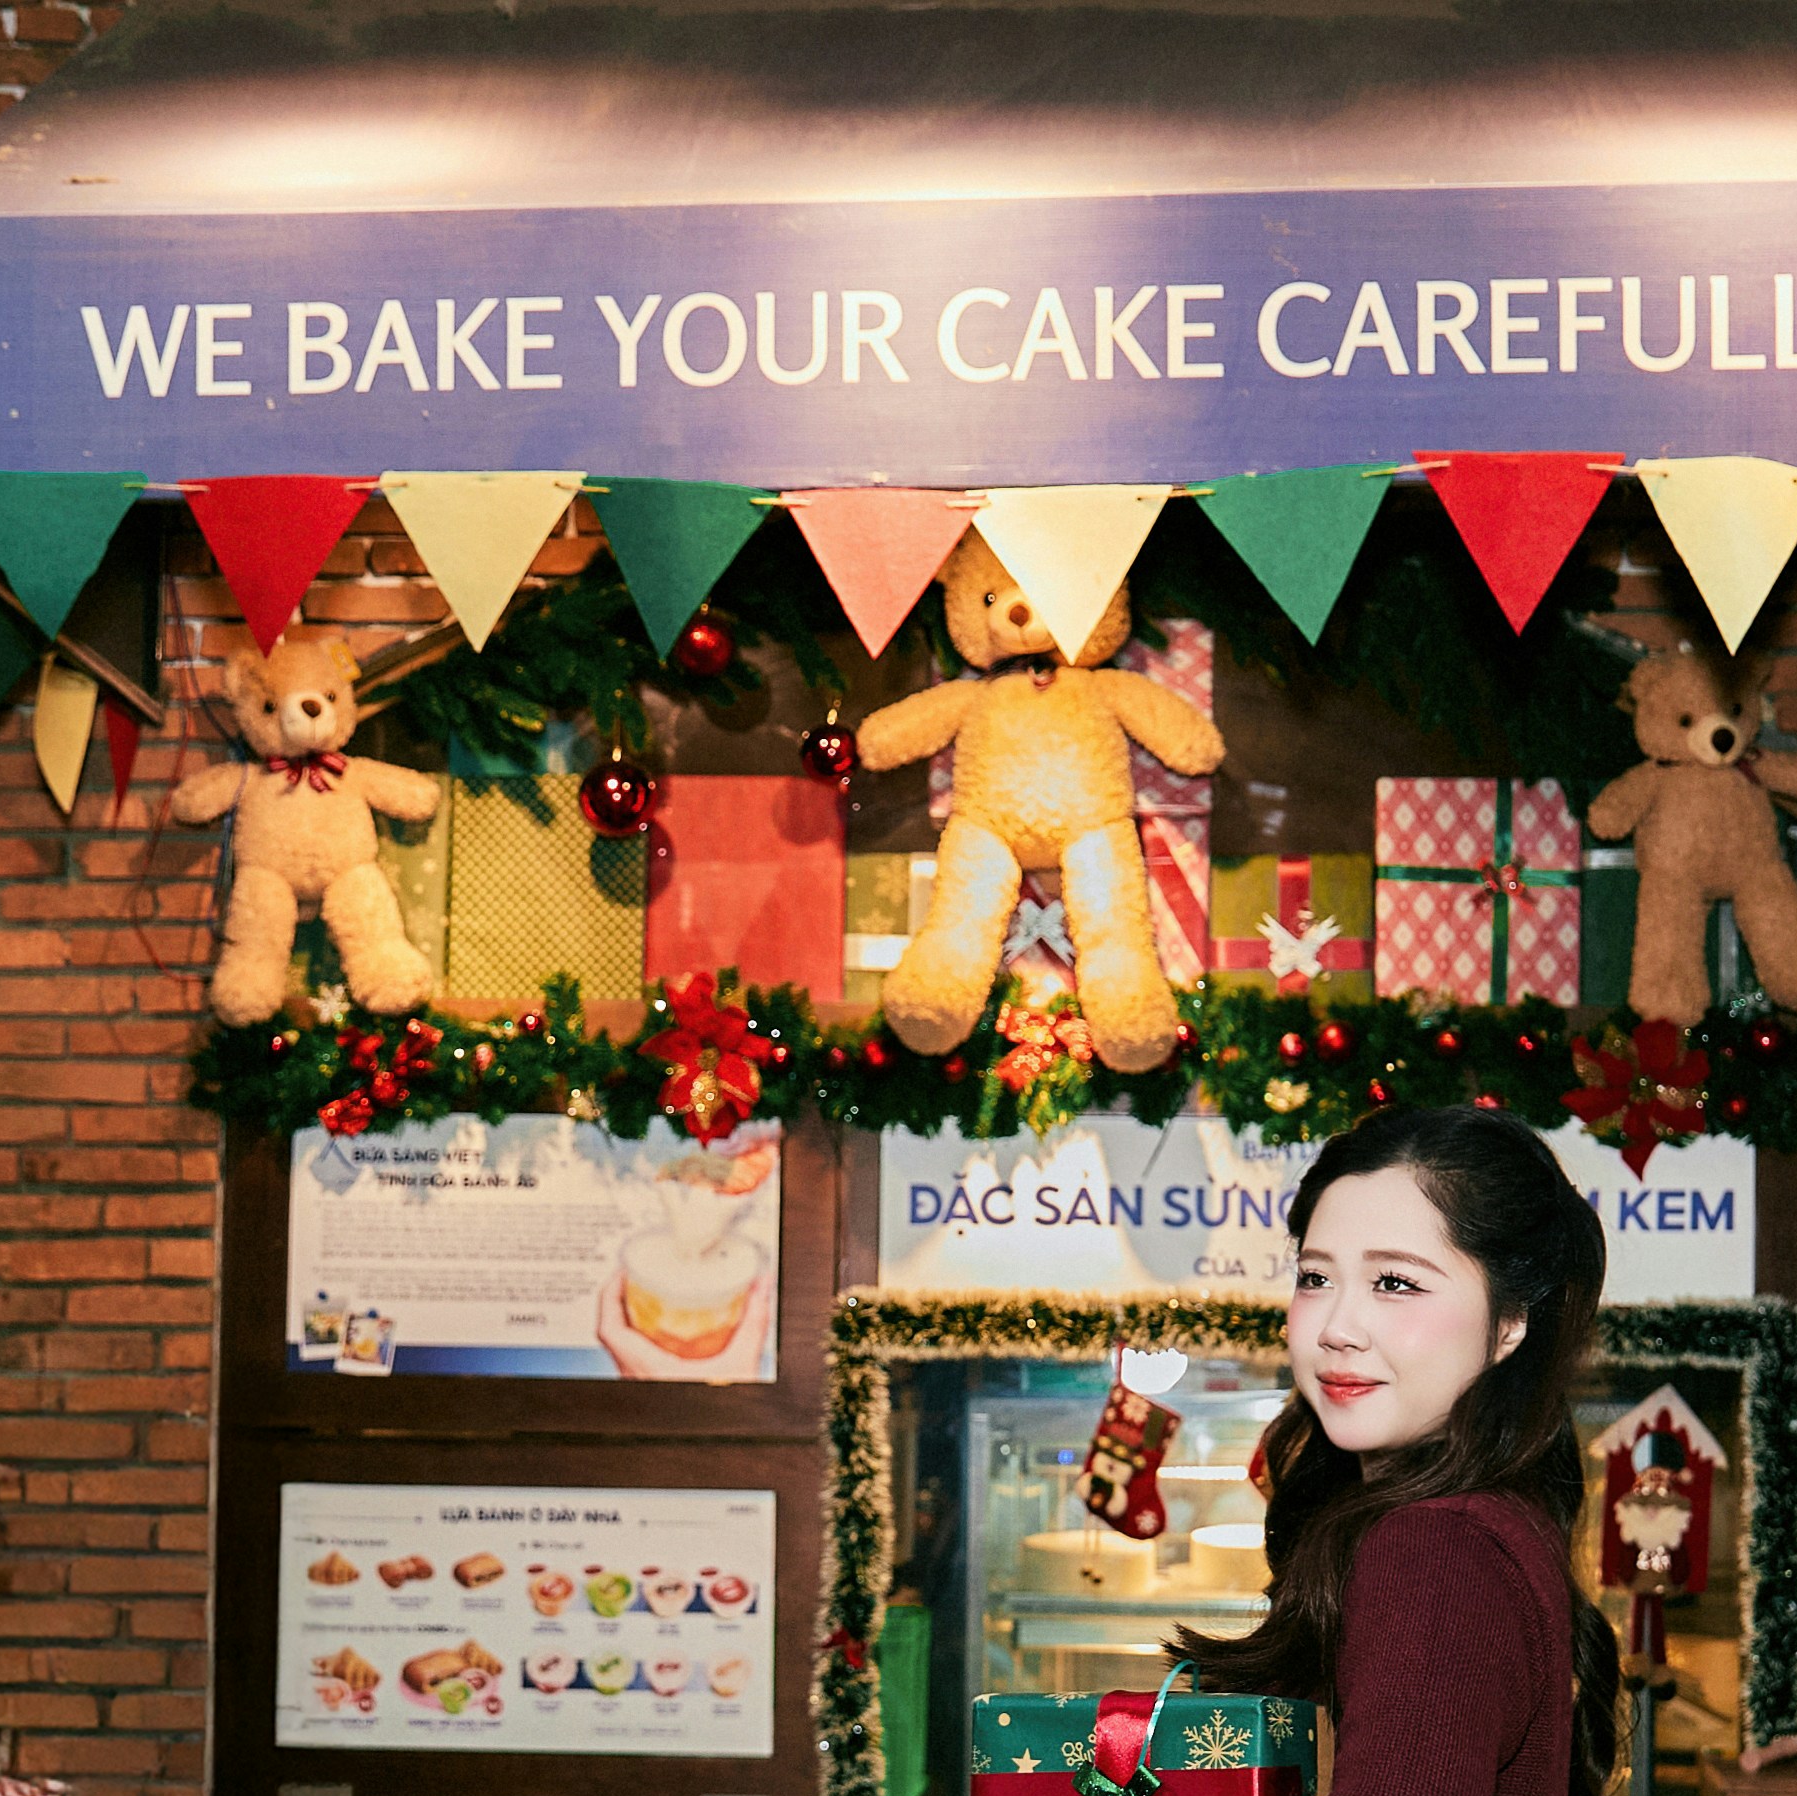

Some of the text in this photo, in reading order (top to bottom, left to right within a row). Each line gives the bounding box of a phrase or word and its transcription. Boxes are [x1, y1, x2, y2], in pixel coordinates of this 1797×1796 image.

[79, 302, 253, 399] WE
[286, 296, 565, 395] BAKE
[593, 289, 910, 388] YOUR
[936, 283, 1226, 384] CAKE
[909, 1171, 1015, 1236] ĐẶC
[1035, 1169, 1143, 1227] SẢN
[1618, 1190, 1735, 1231] KEM
